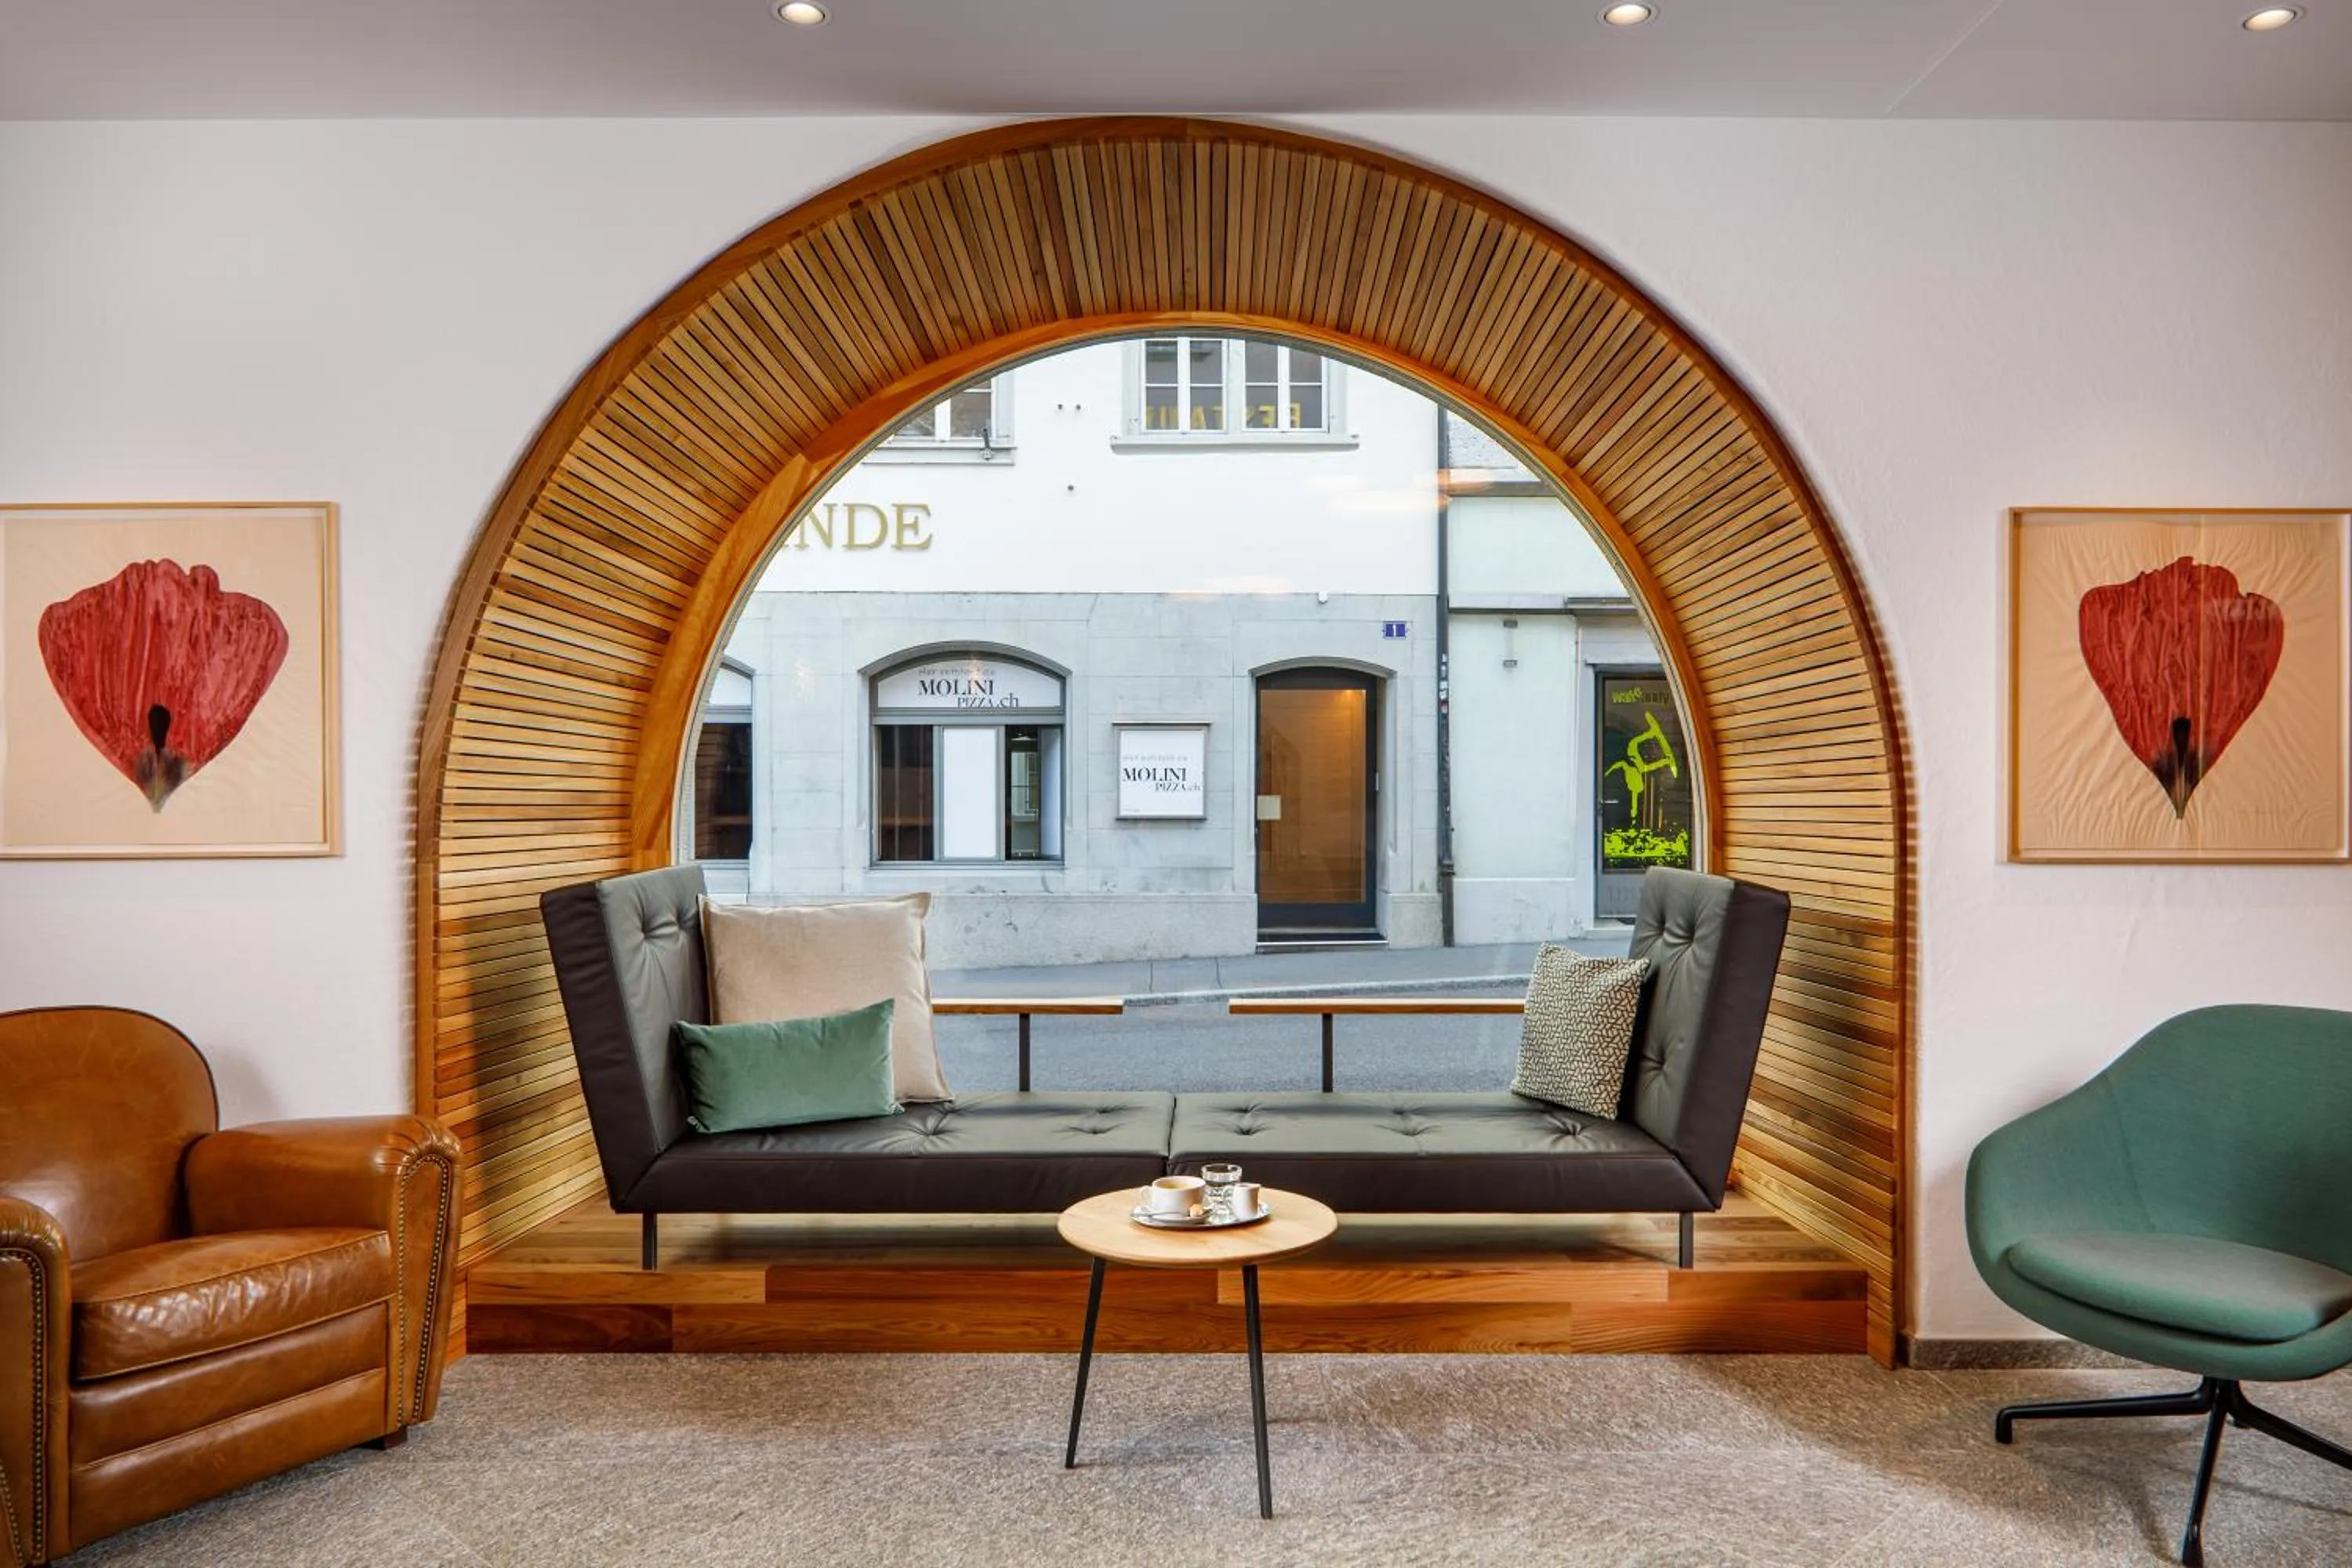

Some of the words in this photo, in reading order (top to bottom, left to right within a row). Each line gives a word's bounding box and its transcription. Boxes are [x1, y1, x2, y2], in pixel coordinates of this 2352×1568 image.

[782, 502, 934, 551] NDE
[918, 678, 994, 696] MOLINI
[1123, 767, 1187, 782] MOLINI
